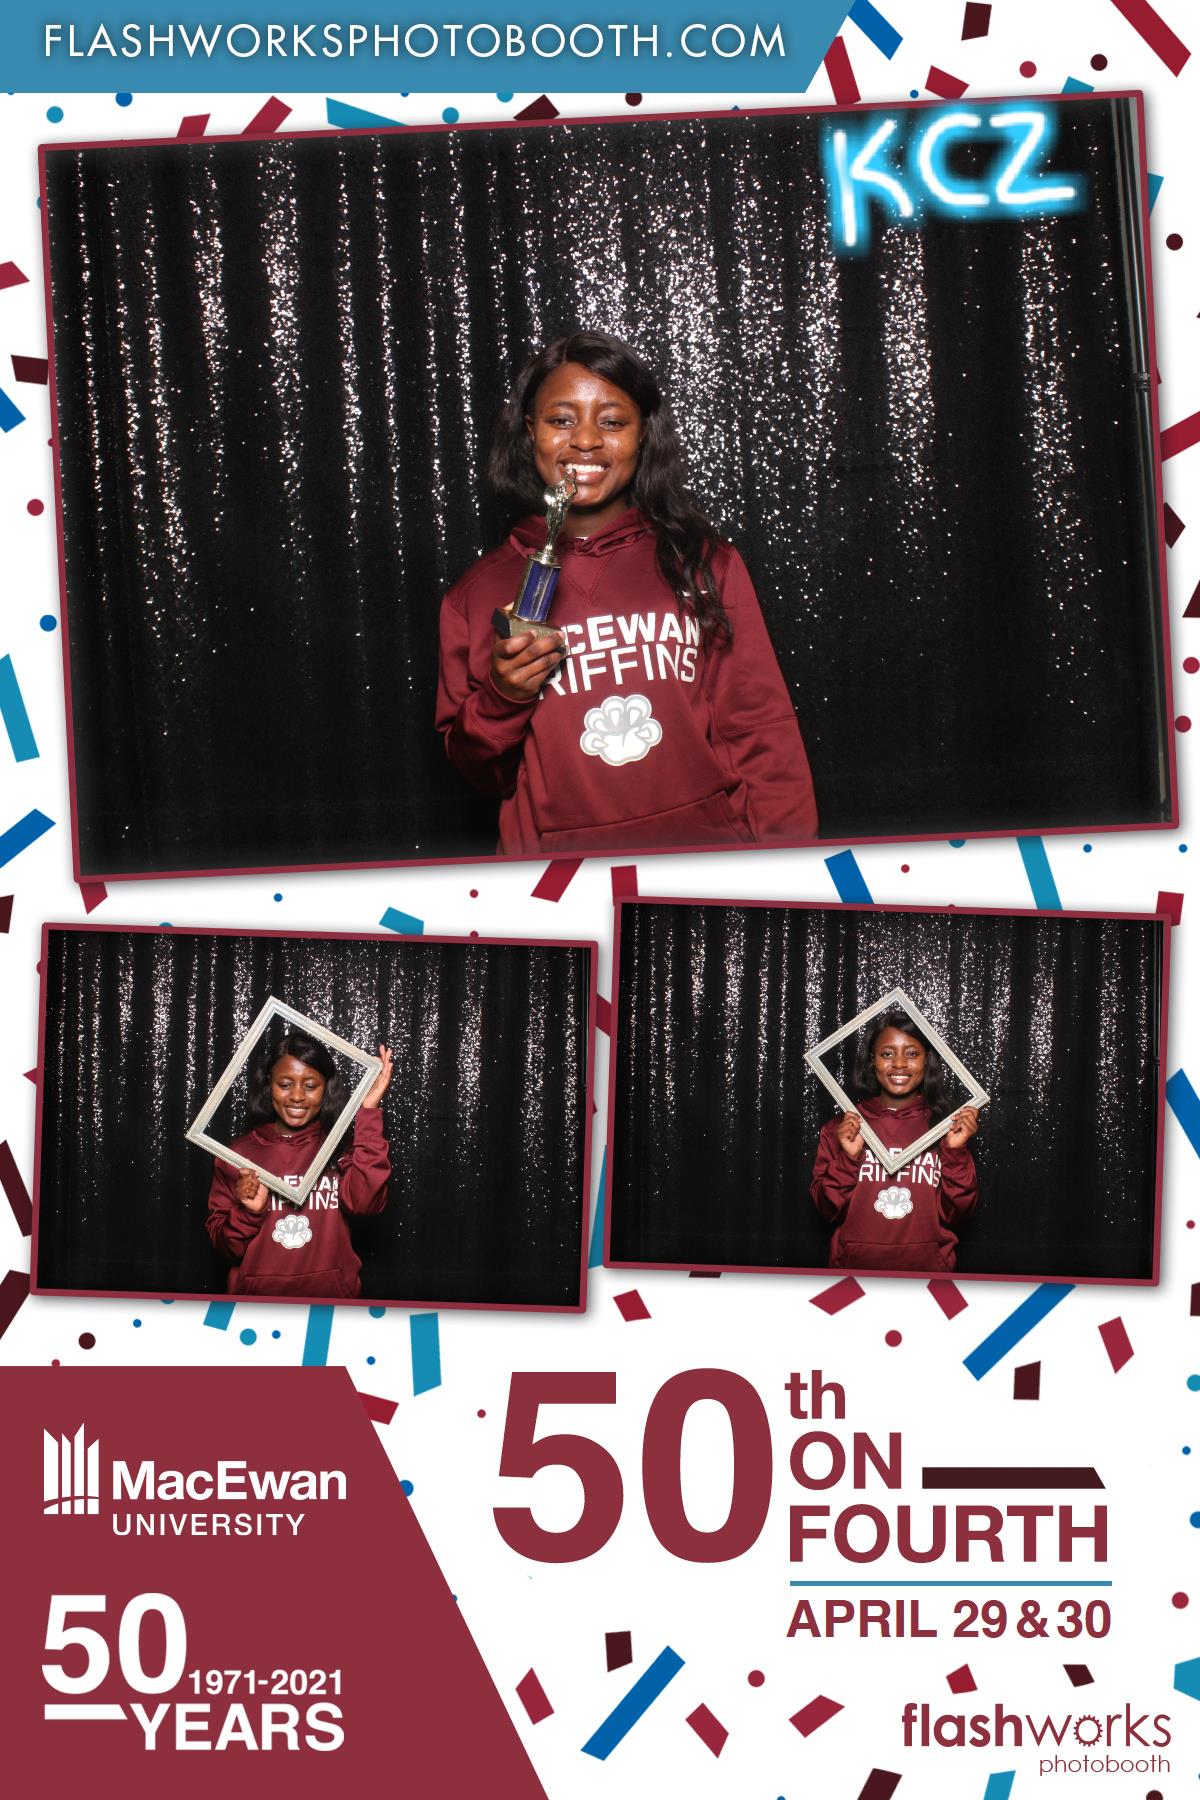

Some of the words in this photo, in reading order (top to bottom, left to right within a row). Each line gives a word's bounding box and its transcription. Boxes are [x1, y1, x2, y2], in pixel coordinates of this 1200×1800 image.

[559, 611, 700, 656] CEWAN
[538, 643, 698, 701] RIFFINS
[858, 1164, 942, 1188] RIFFINS
